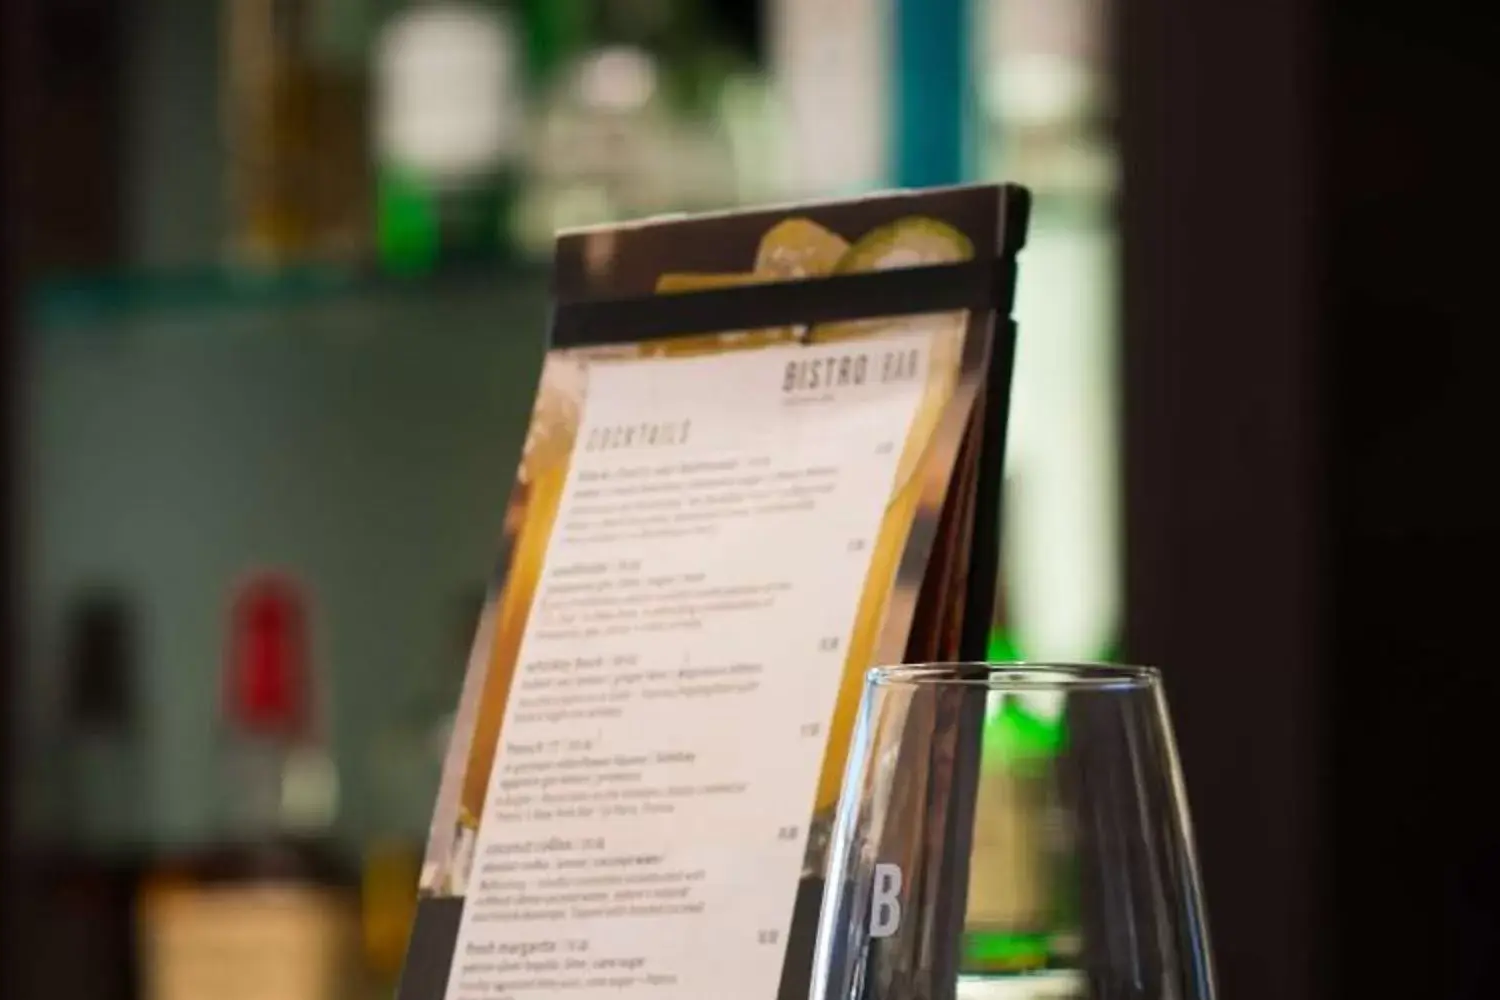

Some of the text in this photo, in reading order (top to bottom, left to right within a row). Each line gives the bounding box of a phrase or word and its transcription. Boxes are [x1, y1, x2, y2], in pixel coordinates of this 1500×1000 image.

[782, 350, 918, 392] BISTRO BAR
[585, 419, 692, 453] COCKTAILS
[869, 863, 902, 938] B
